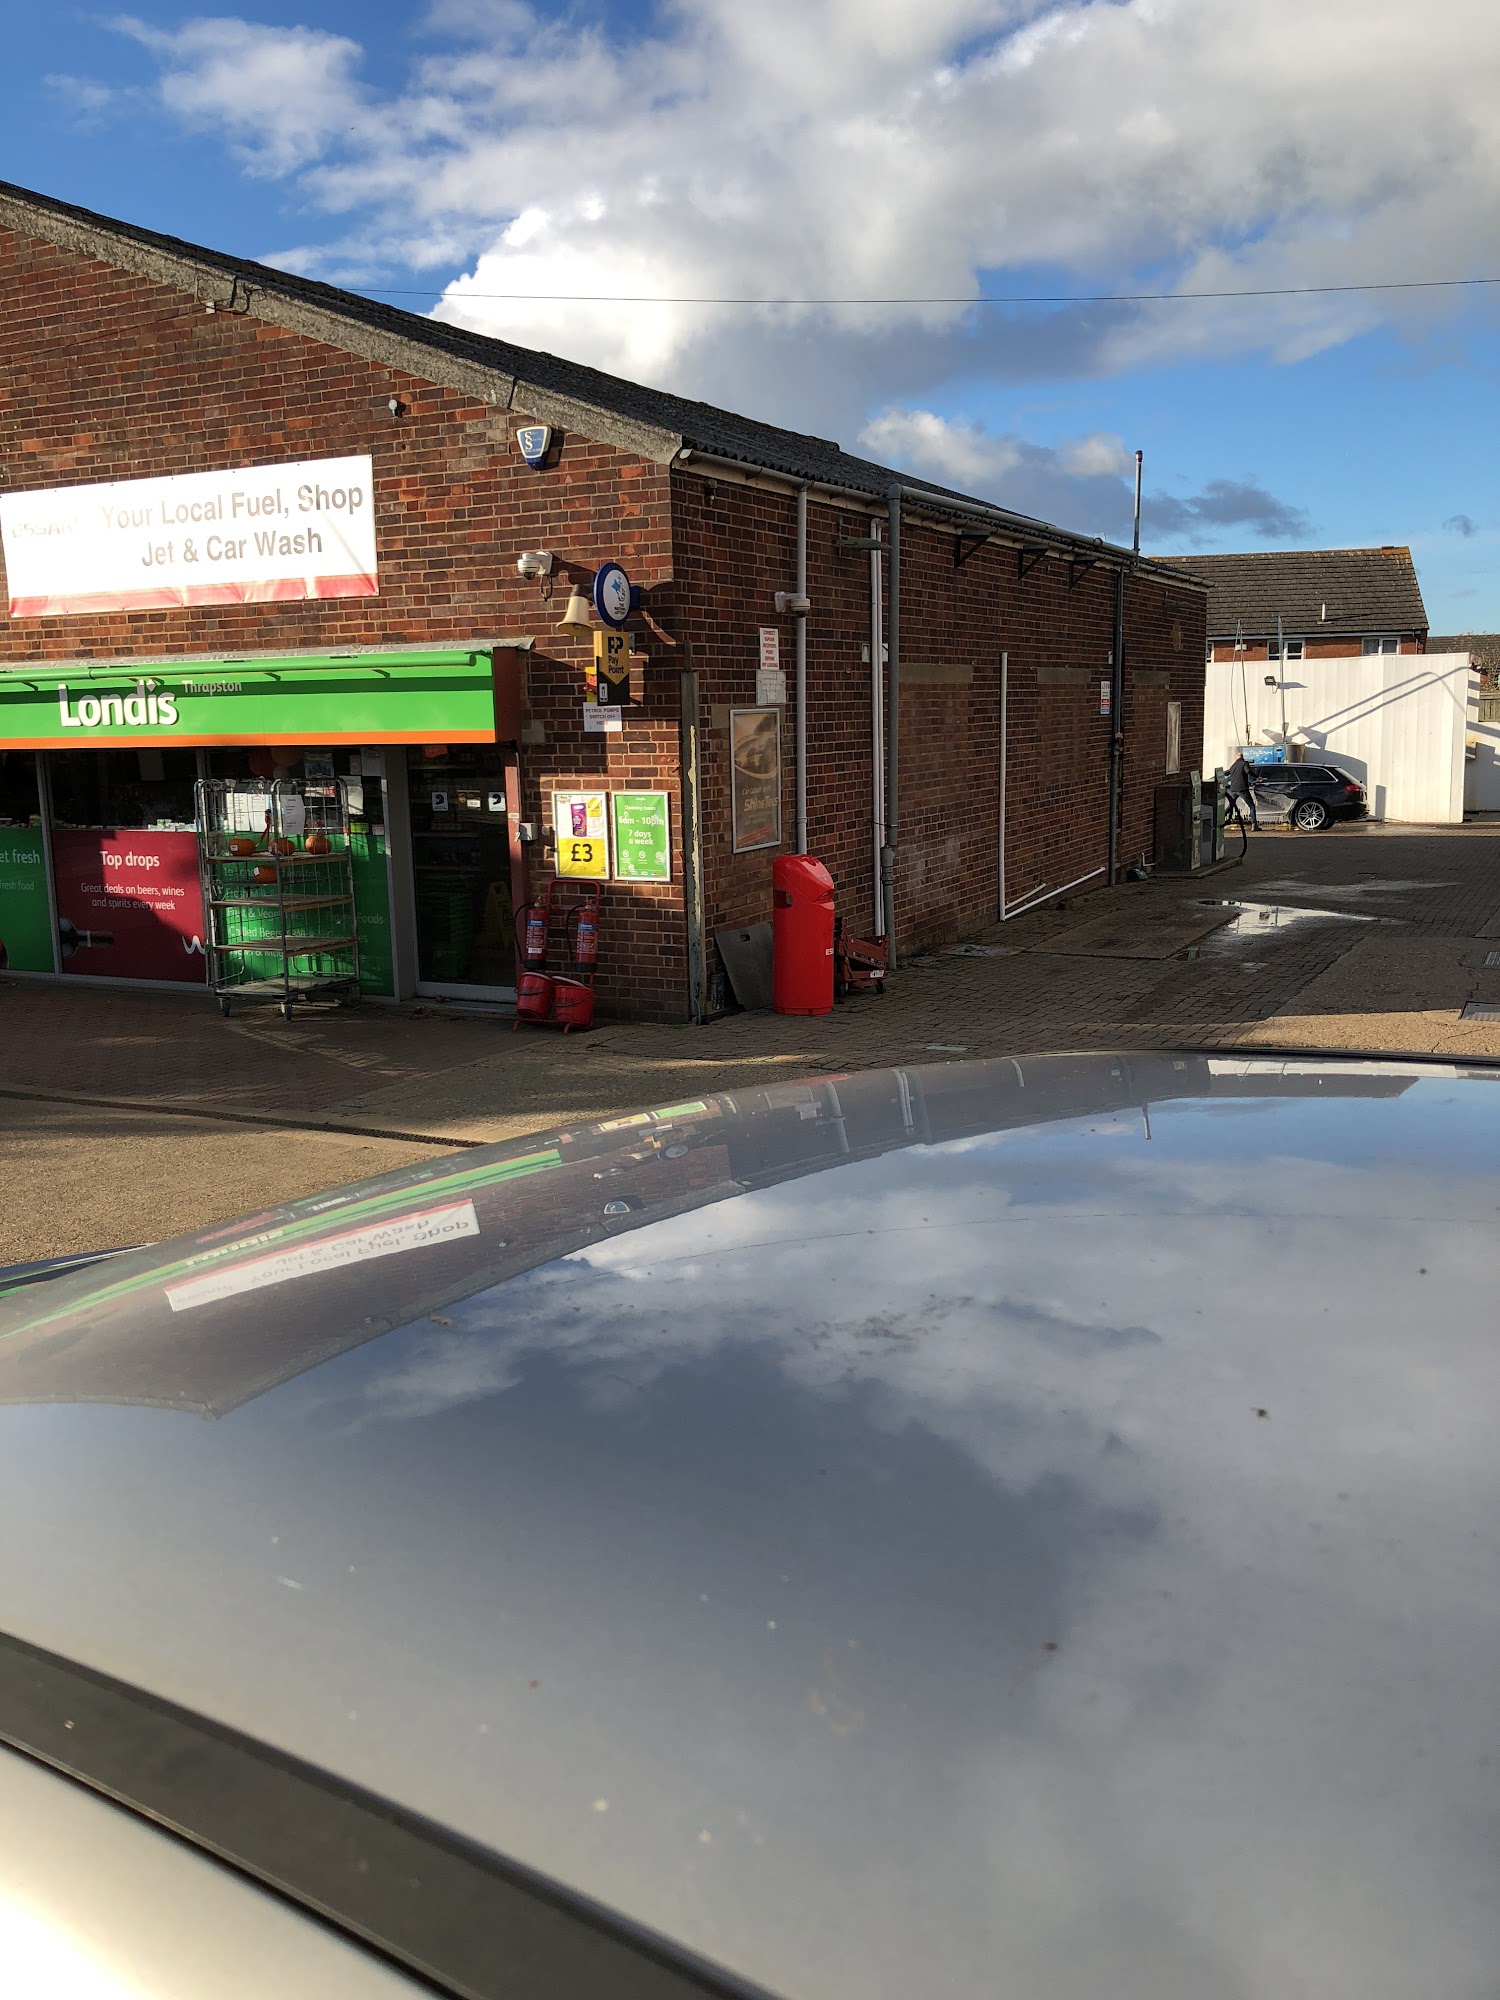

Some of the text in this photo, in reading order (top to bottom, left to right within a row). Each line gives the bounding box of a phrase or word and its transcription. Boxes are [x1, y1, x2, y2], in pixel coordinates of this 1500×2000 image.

[102, 484, 364, 529] Your Local Fuel, Shop
[142, 527, 323, 567] Jet & Car Wash
[608, 655, 620, 667] Pay
[608, 665, 625, 674] Point
[58, 678, 243, 727] Londis Thrapston
[624, 804, 643, 812] Opening
[618, 815, 635, 825] 6am
[641, 816, 665, 827] 10pm
[634, 830, 651, 839] days
[12, 848, 41, 864] fresh
[571, 843, 593, 863] £3
[99, 850, 160, 871] Top drops
[0, 880, 35, 891] resh food
[80, 882, 185, 897] Great deals on beers, wines
[91, 898, 176, 911] and spirits every week
